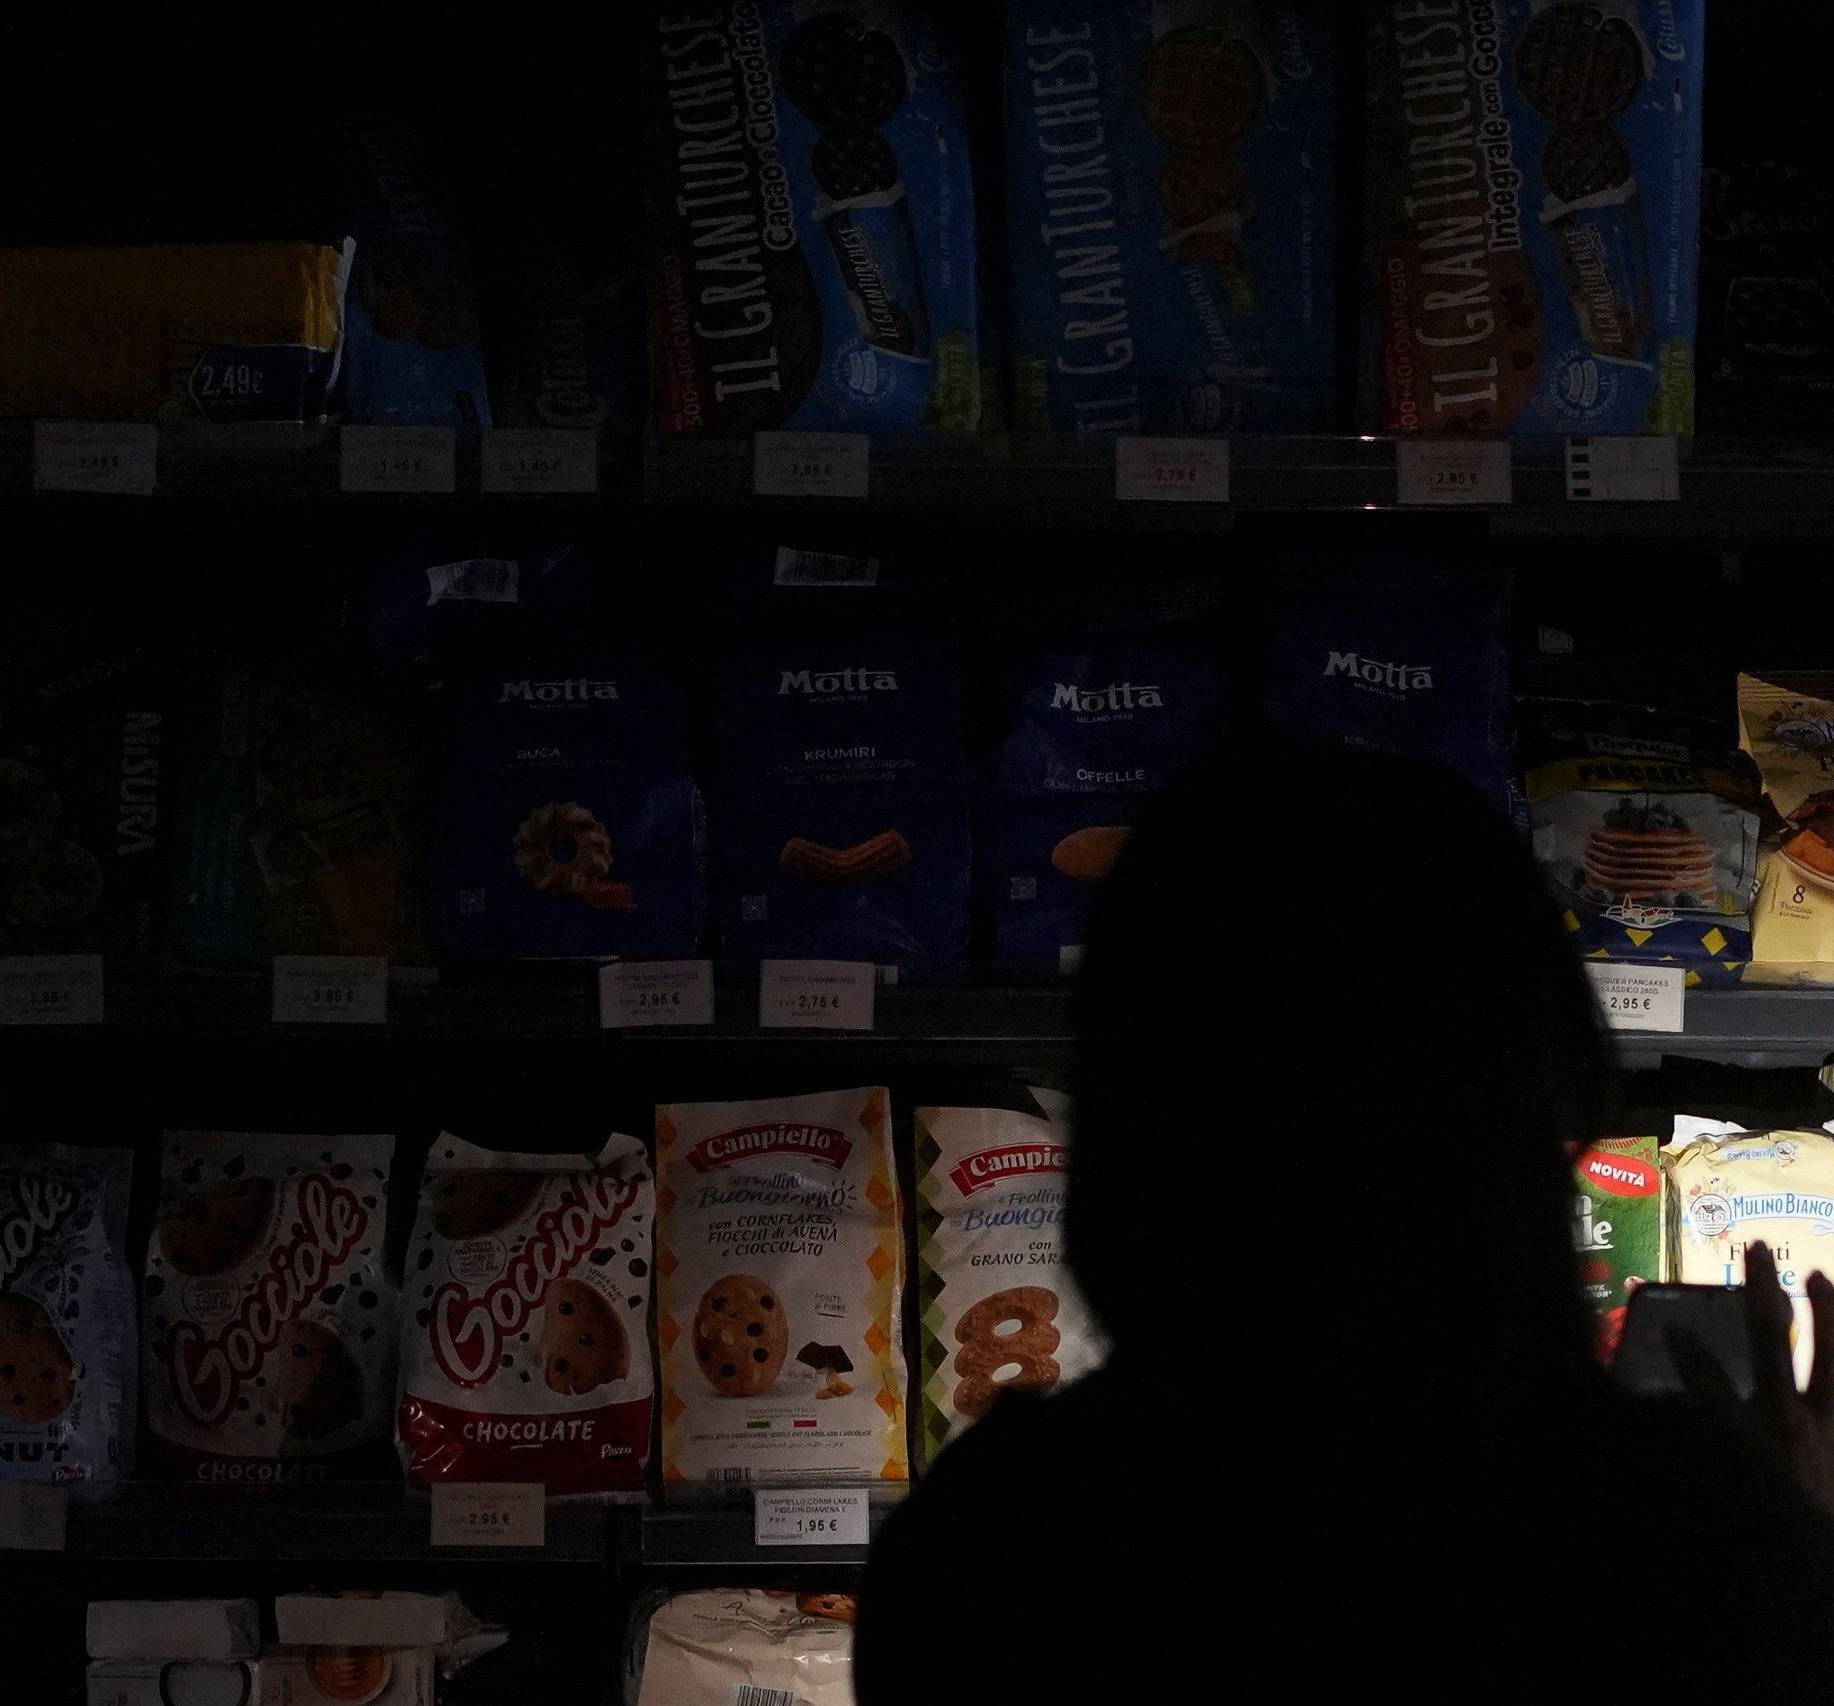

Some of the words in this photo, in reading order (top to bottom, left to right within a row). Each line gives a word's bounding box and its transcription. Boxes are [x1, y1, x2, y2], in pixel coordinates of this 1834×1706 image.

[731, 3, 776, 146] Cioccolato
[658, 8, 774, 339] GRANTURCHESE
[761, 162, 795, 249] Cacao
[1026, 20, 1135, 376] GRANTURCHESE
[711, 347, 781, 402] IL
[777, 667, 900, 696] Motta
[1322, 650, 1434, 692] Motta
[498, 677, 621, 705] Motta
[1049, 681, 1165, 716] Motta
[1793, 884, 1806, 905] 8
[1610, 997, 1639, 1011] 2,95
[1643, 998, 1651, 1010] €
[706, 1125, 833, 1161] Campiello
[1589, 1160, 1646, 1189] NOVITÀ
[708, 1228, 768, 1244] FIOCCHI
[737, 1213, 837, 1230] CORNFLAKES,
[734, 1239, 824, 1258] CIOCCOLATO
[971, 1252, 1024, 1267] GRANO
[1029, 1241, 1052, 1250] con
[430, 1167, 639, 1388] Gocciole
[170, 1174, 366, 1425] Gocciole
[461, 1419, 597, 1443] CHOCOLATE
[797, 1519, 824, 1533] 1,95
[829, 1520, 837, 1532] €
